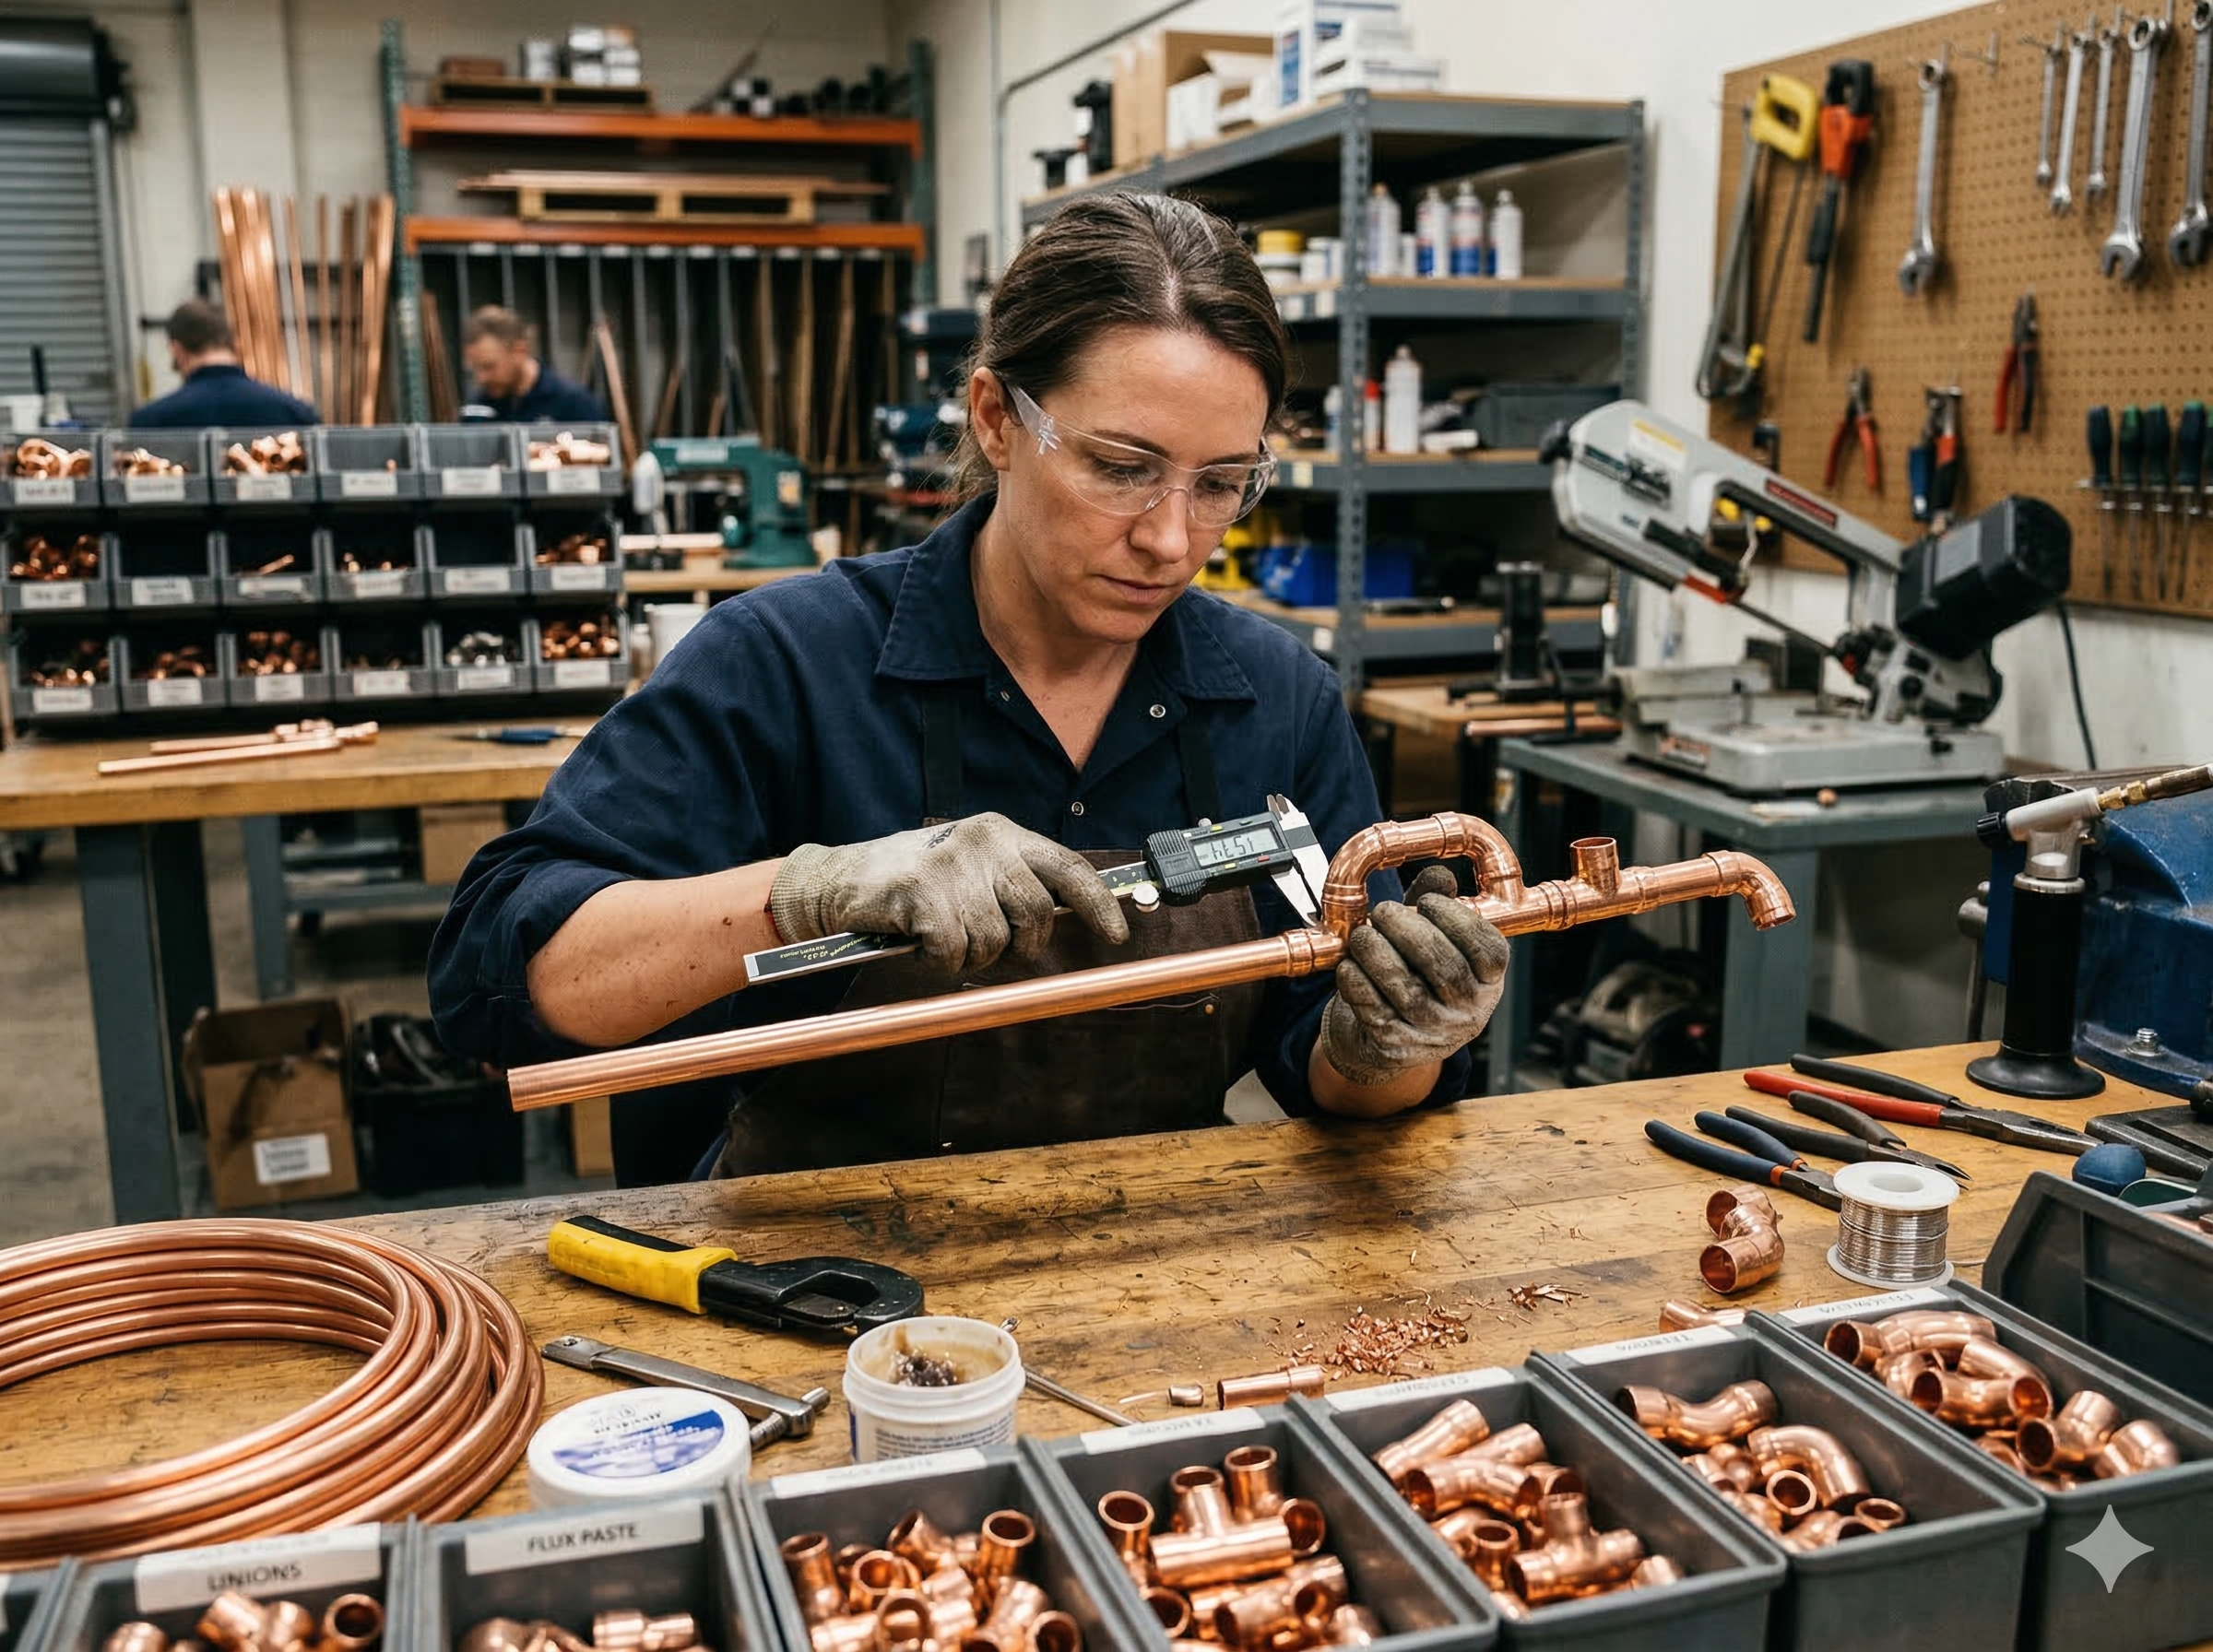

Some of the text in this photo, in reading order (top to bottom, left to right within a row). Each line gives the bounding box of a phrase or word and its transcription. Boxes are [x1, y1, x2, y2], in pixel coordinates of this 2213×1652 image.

[527, 1522, 638, 1552] FLUX PASTE
[207, 1563, 302, 1591] UNIONS
